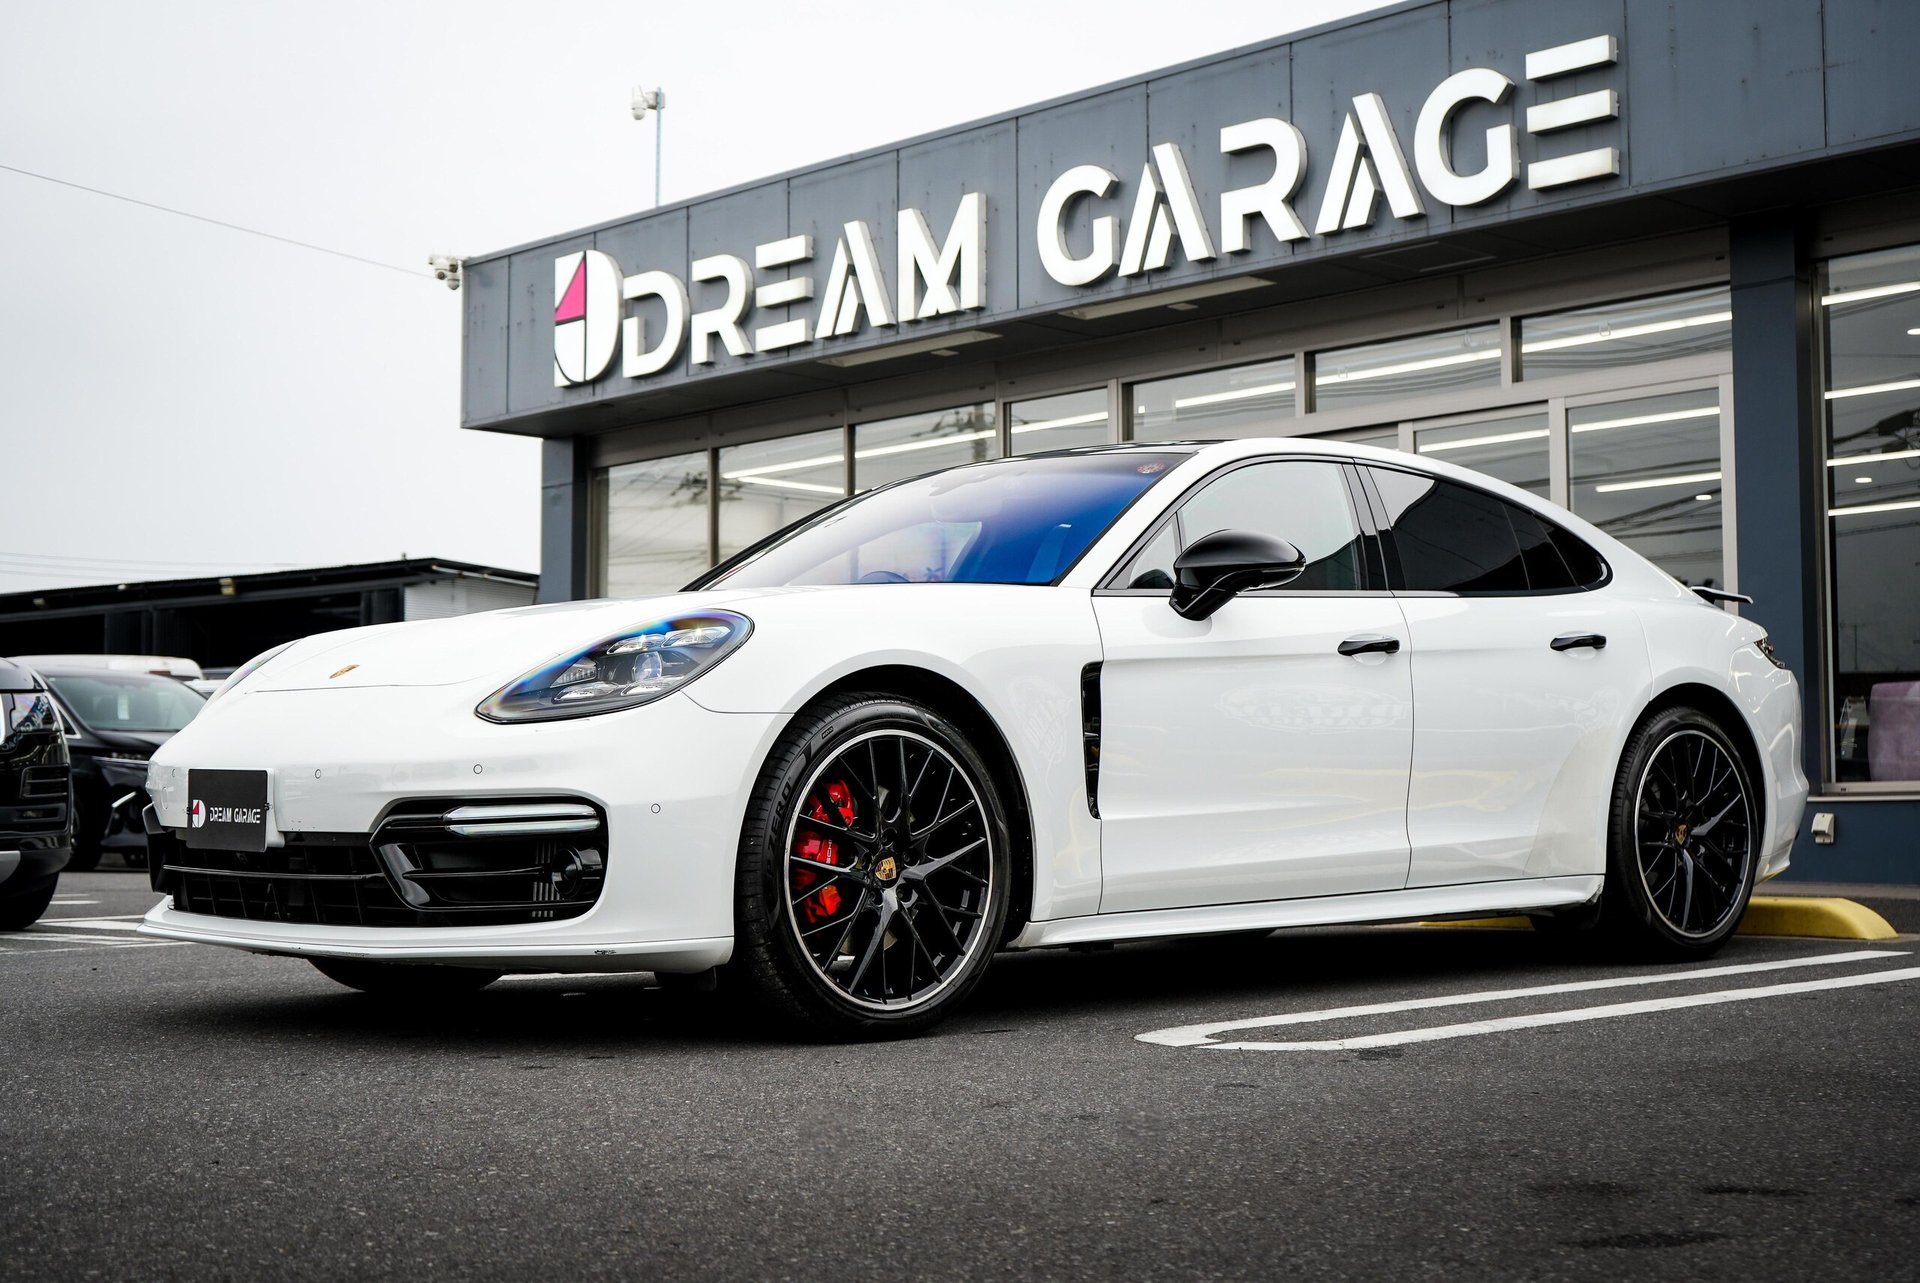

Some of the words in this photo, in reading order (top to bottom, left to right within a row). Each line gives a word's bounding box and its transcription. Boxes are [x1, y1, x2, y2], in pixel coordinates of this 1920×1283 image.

[621, 191, 987, 380] DREAM
[1036, 33, 1621, 288] GARAGE
[209, 807, 232, 823] DREAM
[233, 808, 261, 824] GARAGE
[767, 780, 792, 854] ZERO
